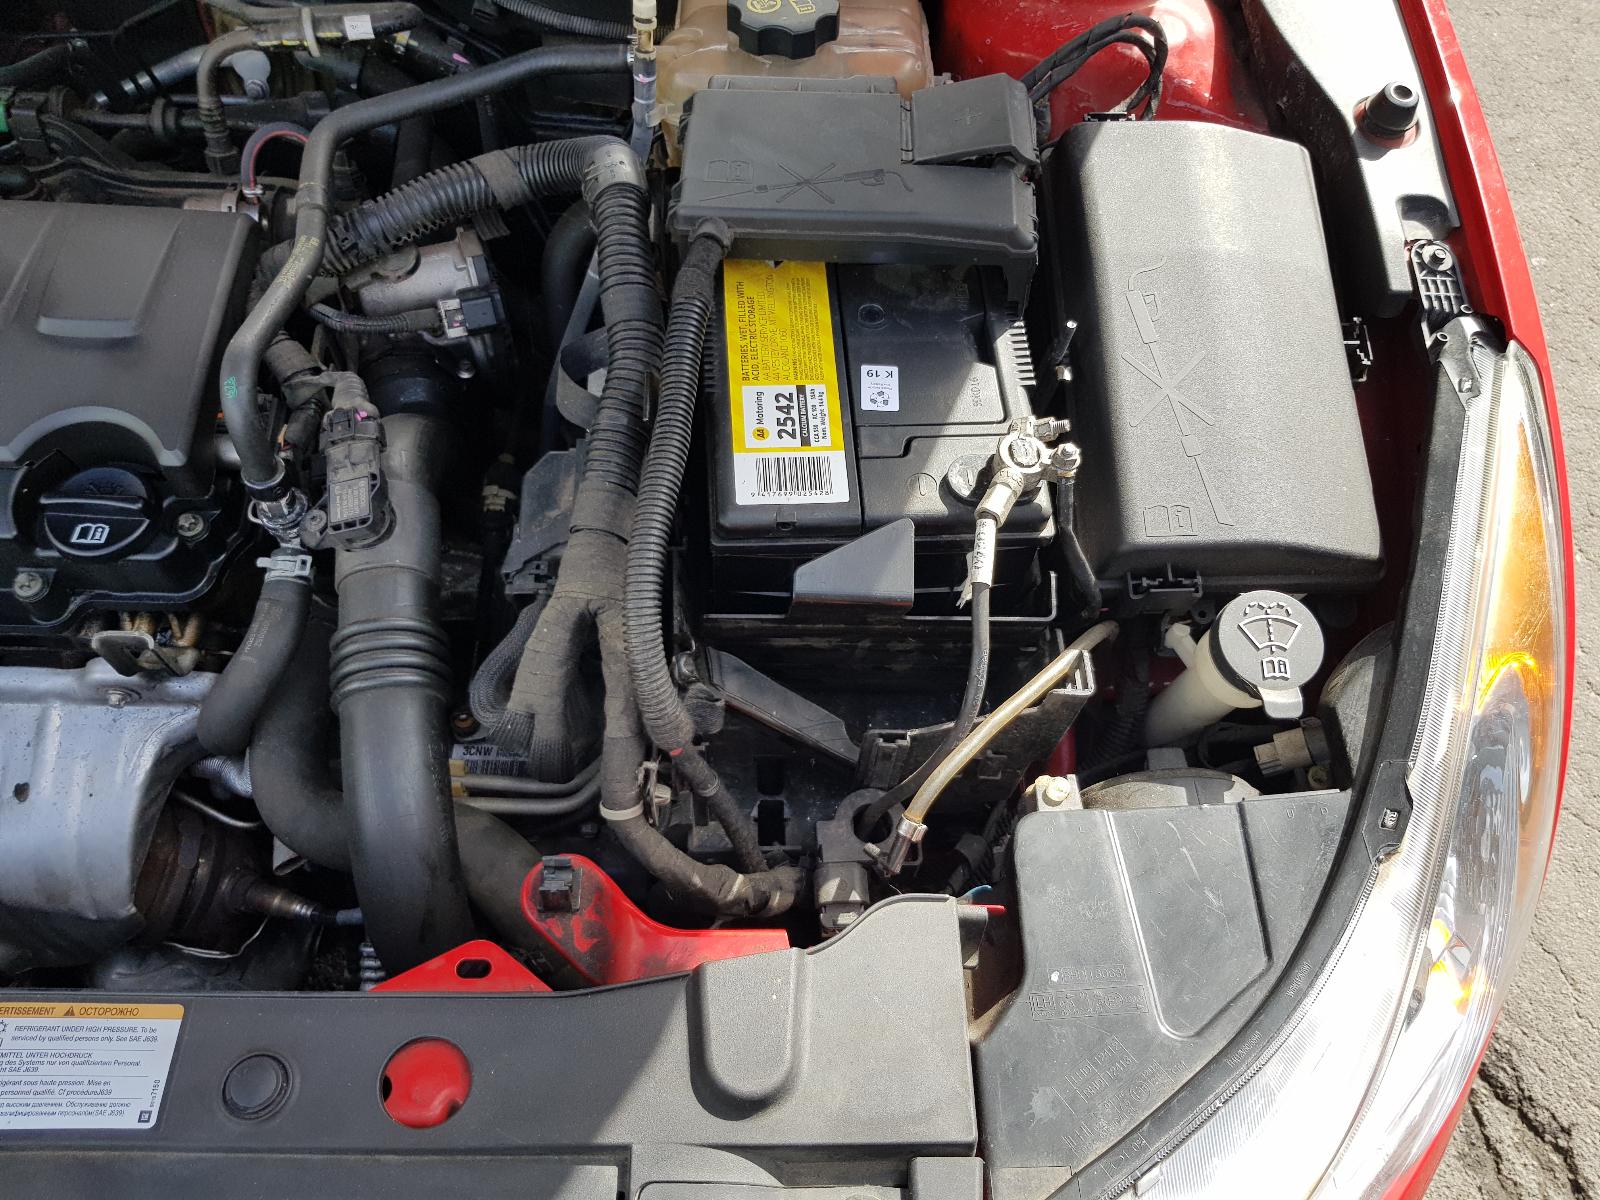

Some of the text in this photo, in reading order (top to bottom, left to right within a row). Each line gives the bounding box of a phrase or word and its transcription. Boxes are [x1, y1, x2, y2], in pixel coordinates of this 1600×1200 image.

[736, 281, 751, 381] BATTERIES, WET, FILLED WITH
[747, 296, 760, 382] ACID, ELECTRIC STORAGE
[867, 369, 893, 378] K 19
[755, 391, 766, 439] AA Motoring
[774, 392, 797, 440] 2542
[799, 394, 809, 437] CALCIUM BATTERY
[462, 745, 494, 756] 3CNW
[80, 1007, 140, 1017] ОСТОРОЖНО
[39, 1034, 47, 1042] by
[48, 1034, 75, 1042] qualified
[18, 1060, 46, 1068] Systems
[0, 1088, 32, 1097] personnel
